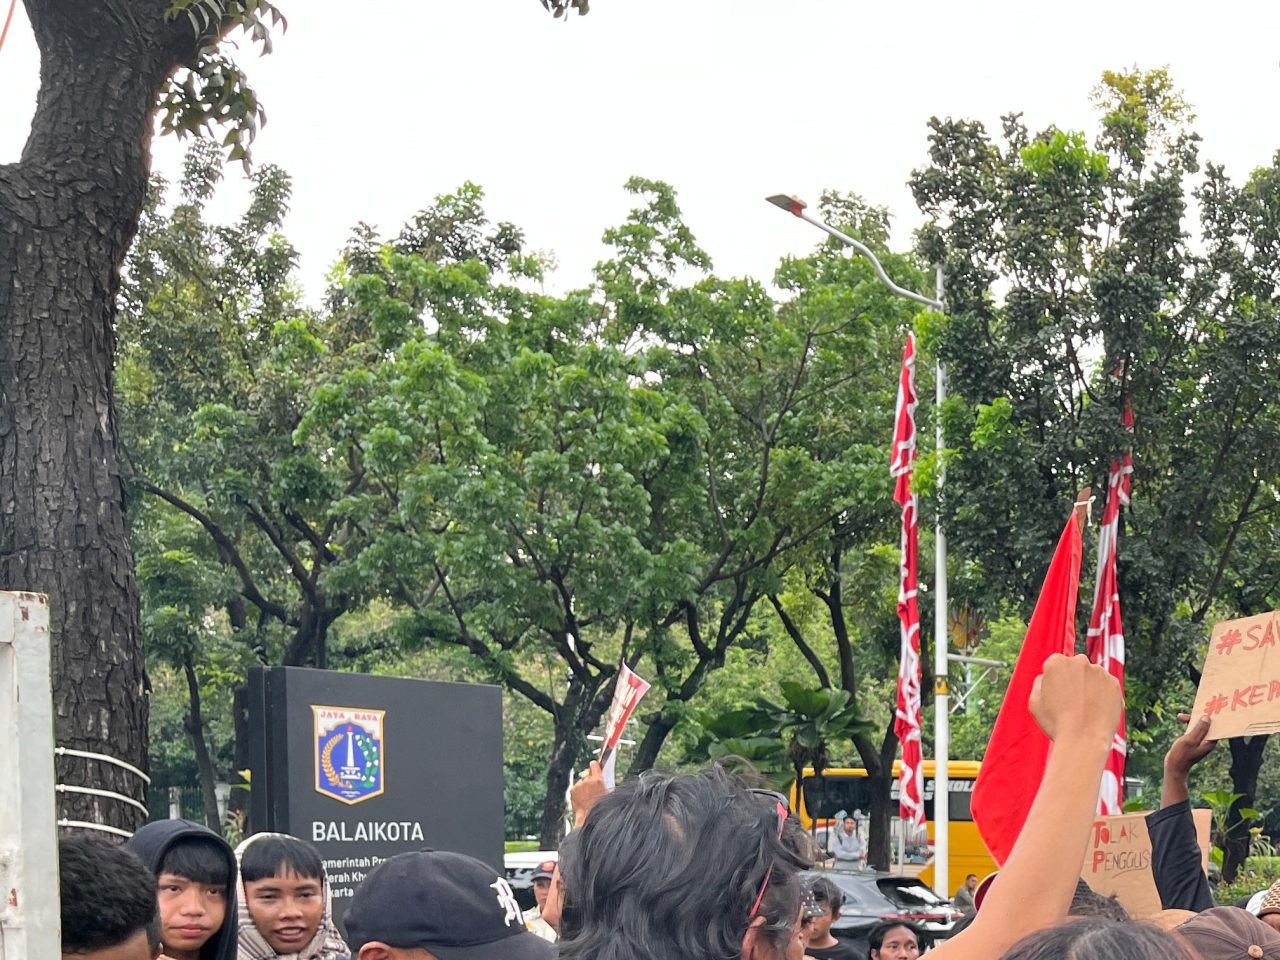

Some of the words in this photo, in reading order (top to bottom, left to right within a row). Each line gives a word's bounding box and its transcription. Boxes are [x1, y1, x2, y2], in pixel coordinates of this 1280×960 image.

[320, 711, 345, 719] JAYA
[354, 713, 378, 721] RAYA
[312, 821, 424, 842] BALAIKOTA
[1093, 821, 1139, 849] TOLAK
[321, 856, 370, 868] emerintah
[1092, 849, 1149, 875] PENGGUS
[328, 872, 350, 883] erah
